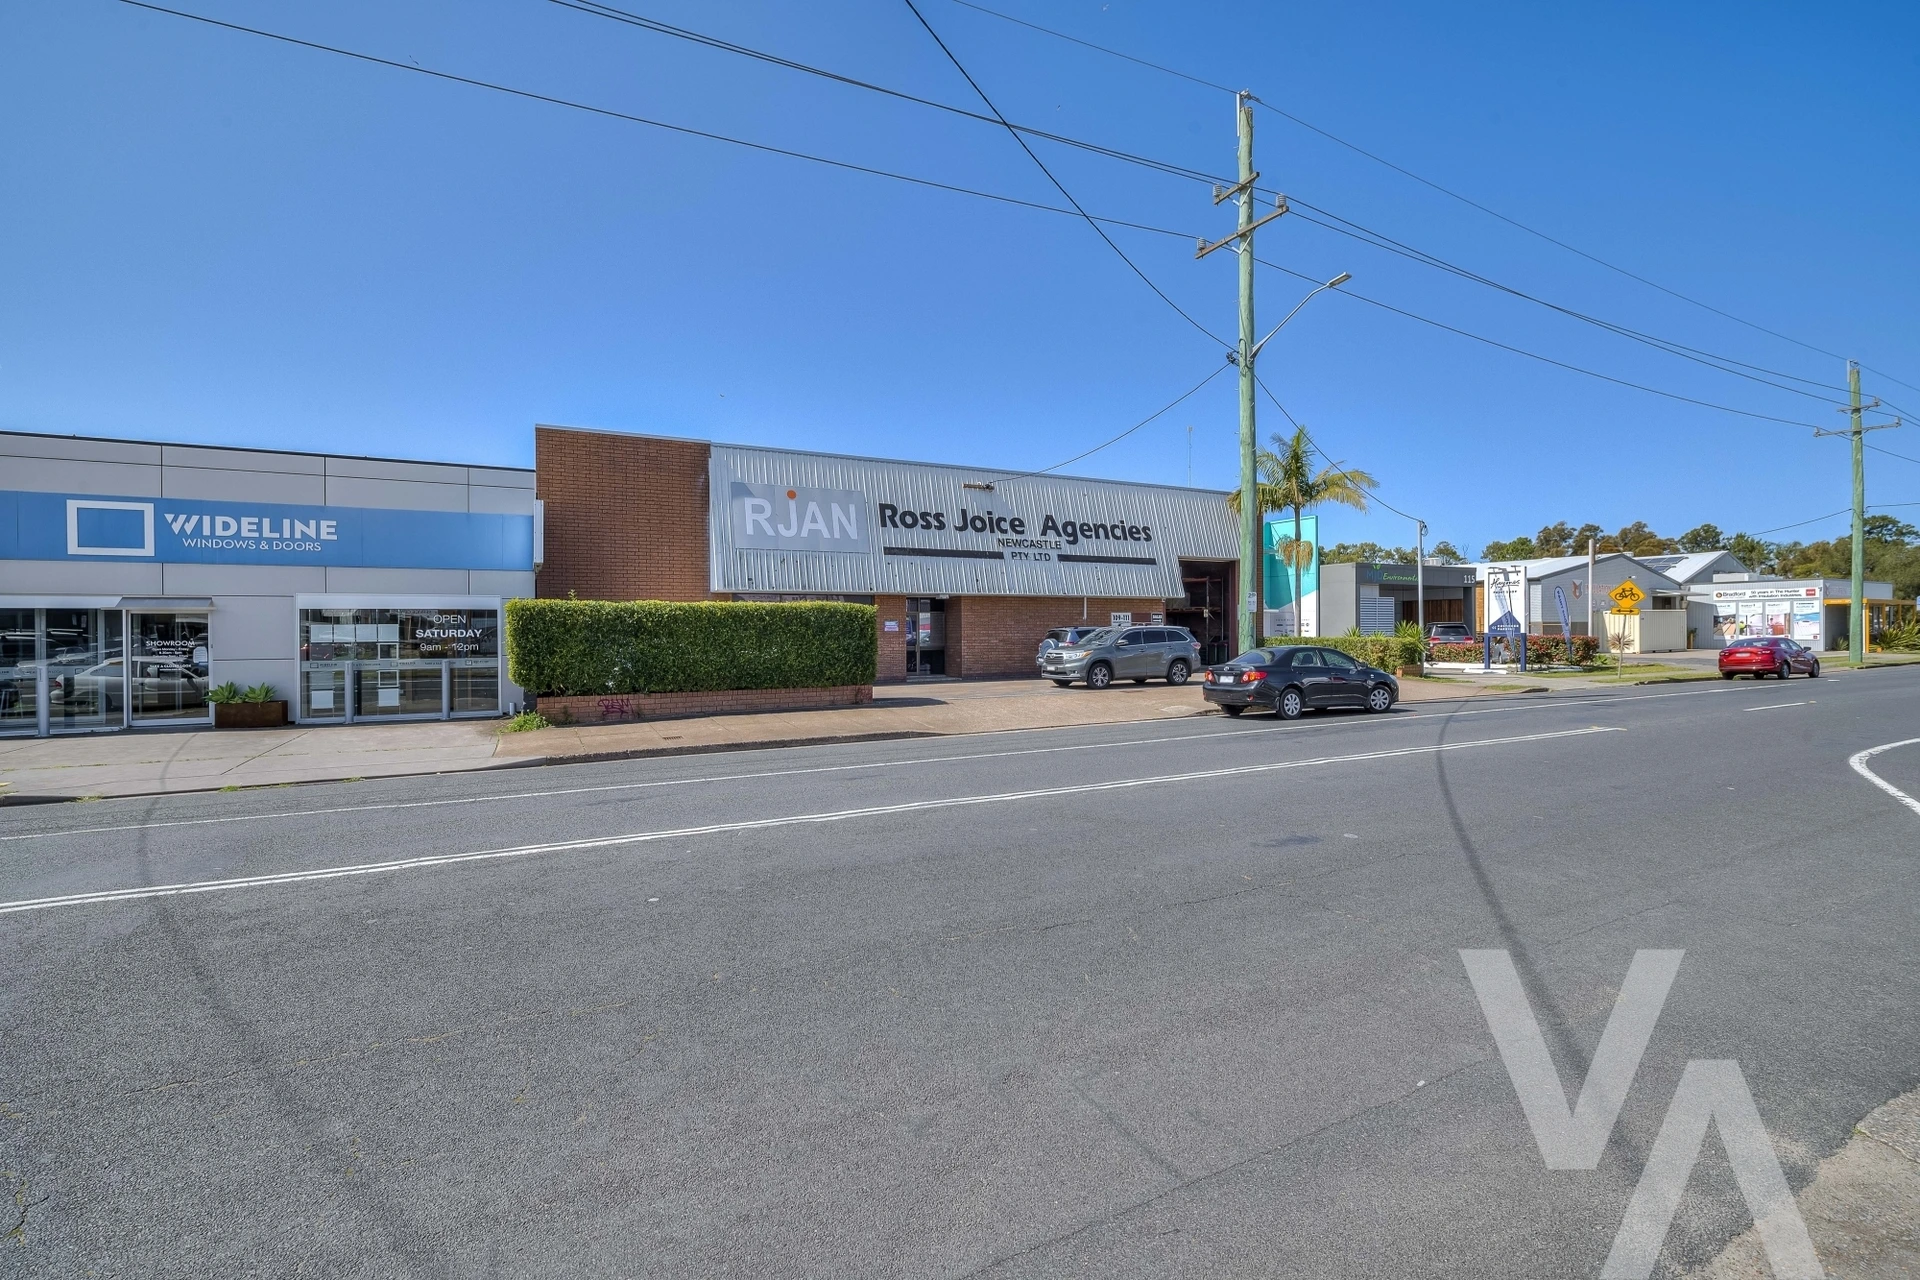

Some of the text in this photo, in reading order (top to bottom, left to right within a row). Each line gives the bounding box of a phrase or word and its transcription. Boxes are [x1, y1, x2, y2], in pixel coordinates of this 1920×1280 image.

[164, 513, 338, 540] WIDELINE
[879, 502, 1153, 545] Ross Joice Agencies
[182, 537, 321, 551] WINDOWS & DOORS
[997, 538, 1062, 550] NEWCASTLE
[1011, 552, 1051, 561] PTY LTD
[1463, 574, 1475, 584] 115
[433, 614, 466, 624] OPEN
[415, 629, 482, 638] SATURDAY
[420, 643, 441, 652] 9am
[452, 643, 479, 652] 12pm
